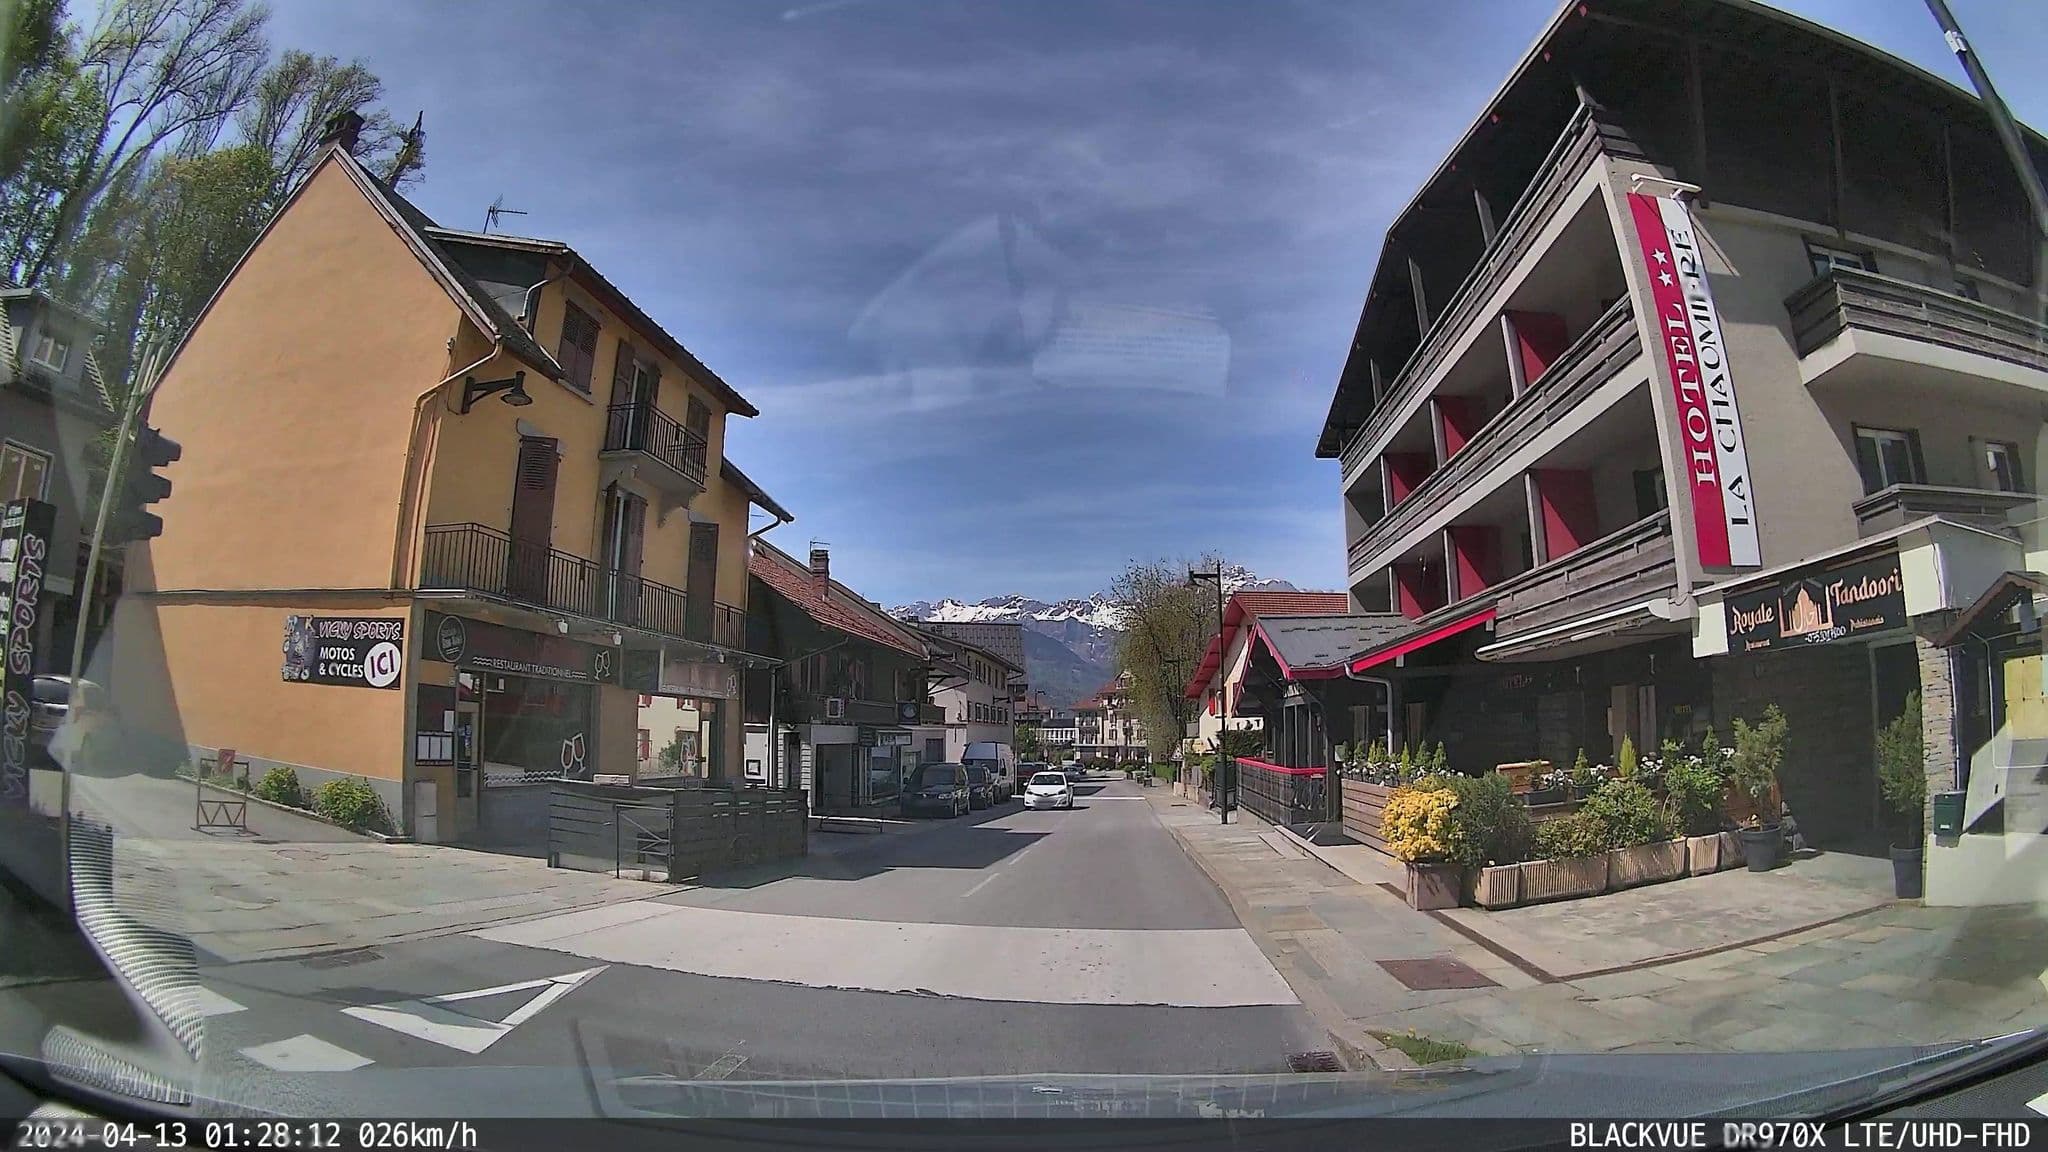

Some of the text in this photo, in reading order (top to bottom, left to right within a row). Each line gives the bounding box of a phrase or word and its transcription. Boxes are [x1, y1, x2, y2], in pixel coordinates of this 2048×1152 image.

[1671, 228, 1749, 526] LA CHAUMIRE
[1665, 303, 1715, 488] HOTEL
[9, 533, 45, 675] SPORTS
[1730, 602, 1775, 635] Royale
[1830, 568, 1903, 607] Tandoori
[353, 621, 401, 640] SPORTS
[319, 647, 355, 660] MOTOS
[369, 649, 395, 678] ICI
[493, 658, 572, 678] RESTAURANT TRADITIONNEL
[319, 662, 364, 678] & CYCLES
